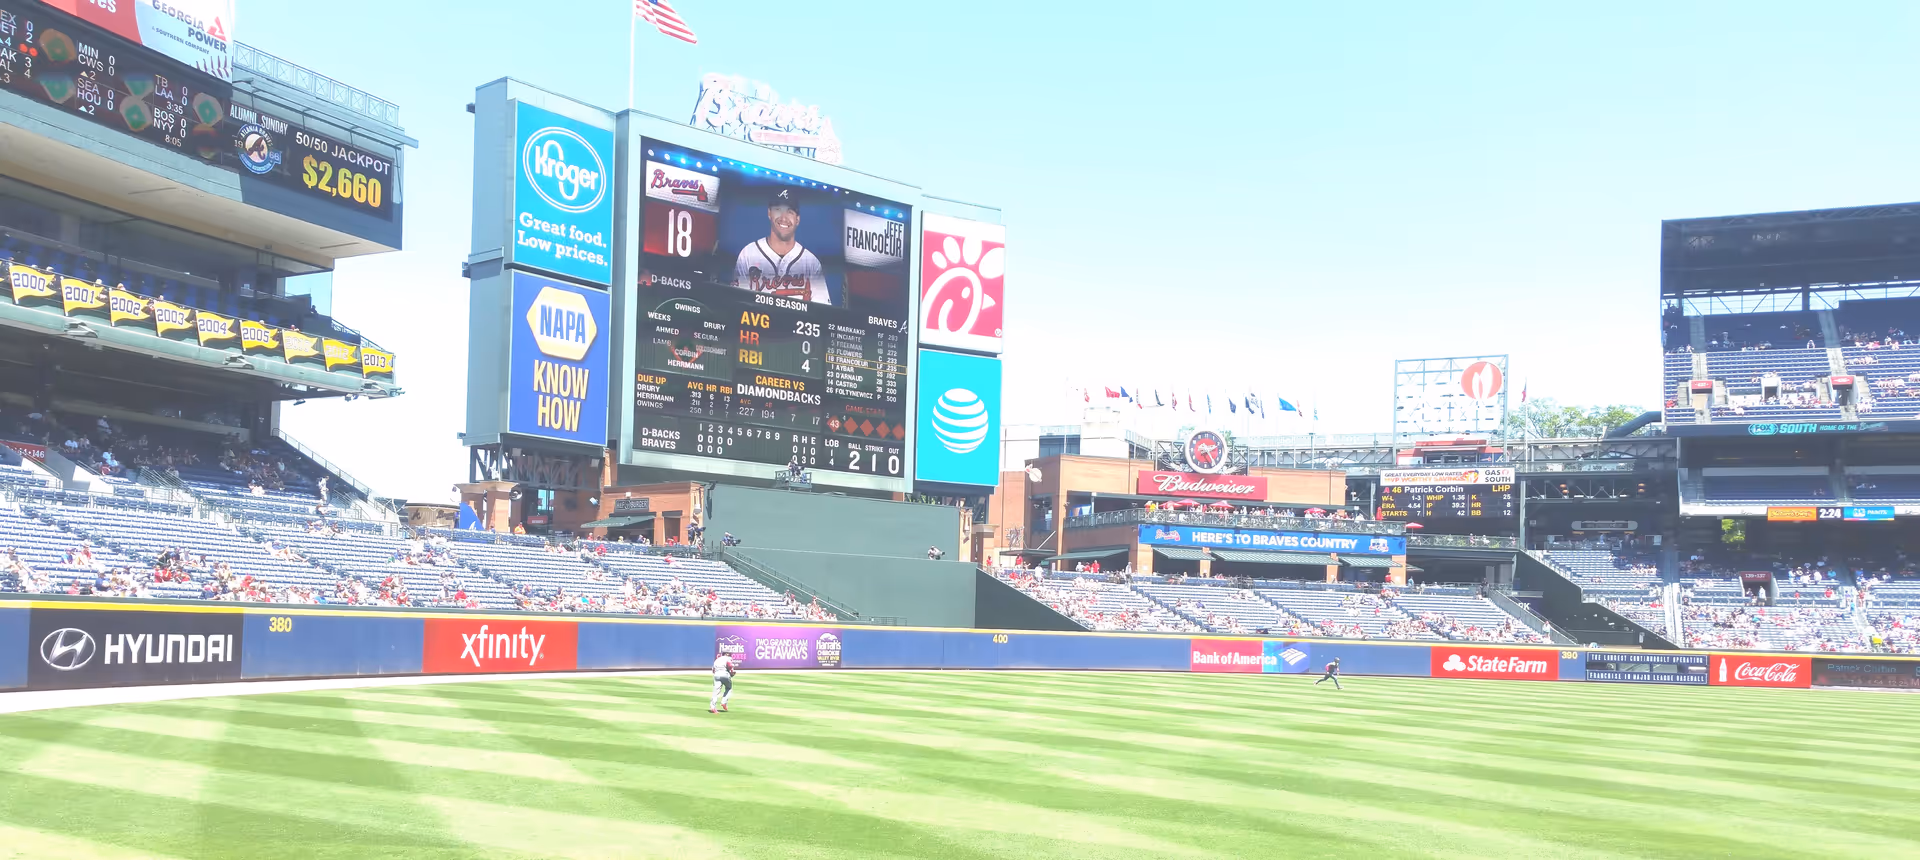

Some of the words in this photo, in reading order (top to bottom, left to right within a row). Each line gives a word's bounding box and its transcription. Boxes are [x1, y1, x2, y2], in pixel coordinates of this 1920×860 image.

[153, 0, 205, 31] GEORGIA
[156, 27, 184, 45] SOUTHERN
[185, 40, 209, 54] COMPANY
[187, 28, 227, 53] POWER
[78, 42, 98, 59] MIN
[78, 54, 104, 71] CWS
[78, 78, 99, 94] SEA
[155, 74, 168, 88] TB
[77, 88, 101, 105] HOU
[155, 85, 174, 100] LAA
[154, 107, 175, 124] BOS
[166, 101, 183, 115] 3:35
[153, 118, 174, 133] NYY
[230, 104, 258, 125] ALUMNI
[261, 115, 288, 136] SUNDAY
[165, 135, 181, 147] 8:05
[295, 132, 328, 153] 50/50
[332, 145, 390, 175] JACKPOT
[535, 140, 598, 200] Kroger
[303, 154, 381, 207] $2,660
[651, 169, 700, 190] Braves
[519, 212, 566, 237] Great
[569, 225, 607, 248] food.
[667, 209, 692, 257] 18
[884, 221, 903, 238] JEFF
[518, 230, 552, 250] Low
[554, 242, 608, 266] prices.
[846, 226, 902, 258] FRANCOEUR
[12, 272, 45, 292] 2000
[651, 274, 691, 290] D-BACKS
[64, 286, 95, 304] 2001
[755, 294, 774, 306] 2016
[775, 298, 808, 312] SEASON
[111, 297, 140, 316] 2002
[675, 303, 701, 313] OWINGS
[157, 308, 184, 325] 2003
[540, 304, 586, 344] NAPA
[648, 311, 671, 322] WEEKS
[741, 311, 770, 329] AVG
[793, 320, 820, 337] .235
[868, 315, 898, 329] BRAVES
[199, 319, 227, 334] 2004
[656, 326, 680, 335] AHMED
[704, 321, 726, 331] DRURY
[242, 328, 269, 342] 2005
[740, 330, 760, 345] HR
[802, 341, 811, 354] 0
[364, 354, 386, 368] 2013
[668, 359, 704, 371] HERRMANN
[739, 348, 763, 366] RBI
[801, 359, 811, 373] 4
[533, 359, 589, 399] KNOW
[637, 373, 654, 383] DUE
[655, 376, 667, 385] UP
[755, 375, 791, 389] CAREER
[793, 380, 805, 391] VS
[636, 383, 661, 393] DRURY
[687, 381, 704, 391] AVG
[706, 383, 717, 393] HR
[719, 385, 733, 395] RBI
[737, 383, 821, 406] DIAMONDBACKS
[636, 391, 674, 403] HERRMANN
[636, 399, 664, 409] OWINGS
[537, 395, 581, 432] HOW
[830, 419, 840, 429] 43
[1755, 423, 1771, 431] FOX
[1779, 423, 1817, 434] SOUTH
[642, 427, 681, 440] D-BACKS
[642, 437, 676, 450] BRAVES
[824, 439, 840, 448] LOB
[865, 444, 884, 453] STRIKE
[888, 447, 900, 455] OUT
[848, 450, 860, 470] 2
[888, 455, 900, 474] 0
[1153, 474, 1256, 494] Budweiser
[1435, 485, 1464, 493] Corbin
[1819, 508, 1842, 519] 2:24
[1192, 531, 1233, 544] HERE'S
[1235, 533, 1251, 545] TO
[1253, 534, 1298, 548] BRAVES
[1300, 536, 1358, 550] COUNTRY
[269, 616, 292, 632] 380
[460, 624, 546, 667] xfinity
[755, 638, 769, 646] TWO
[769, 638, 792, 647] GRAND
[792, 639, 809, 648] SLAM
[816, 639, 841, 650] Harrah's
[993, 633, 1008, 644] 400
[104, 633, 233, 664] HYUNDAI
[755, 645, 809, 661] GETAWAYS
[1561, 651, 1578, 659] 390
[1193, 651, 1220, 664] Bank
[1219, 652, 1232, 665] of
[1233, 652, 1277, 666] America
[1734, 661, 1800, 683] Coca-Cola
